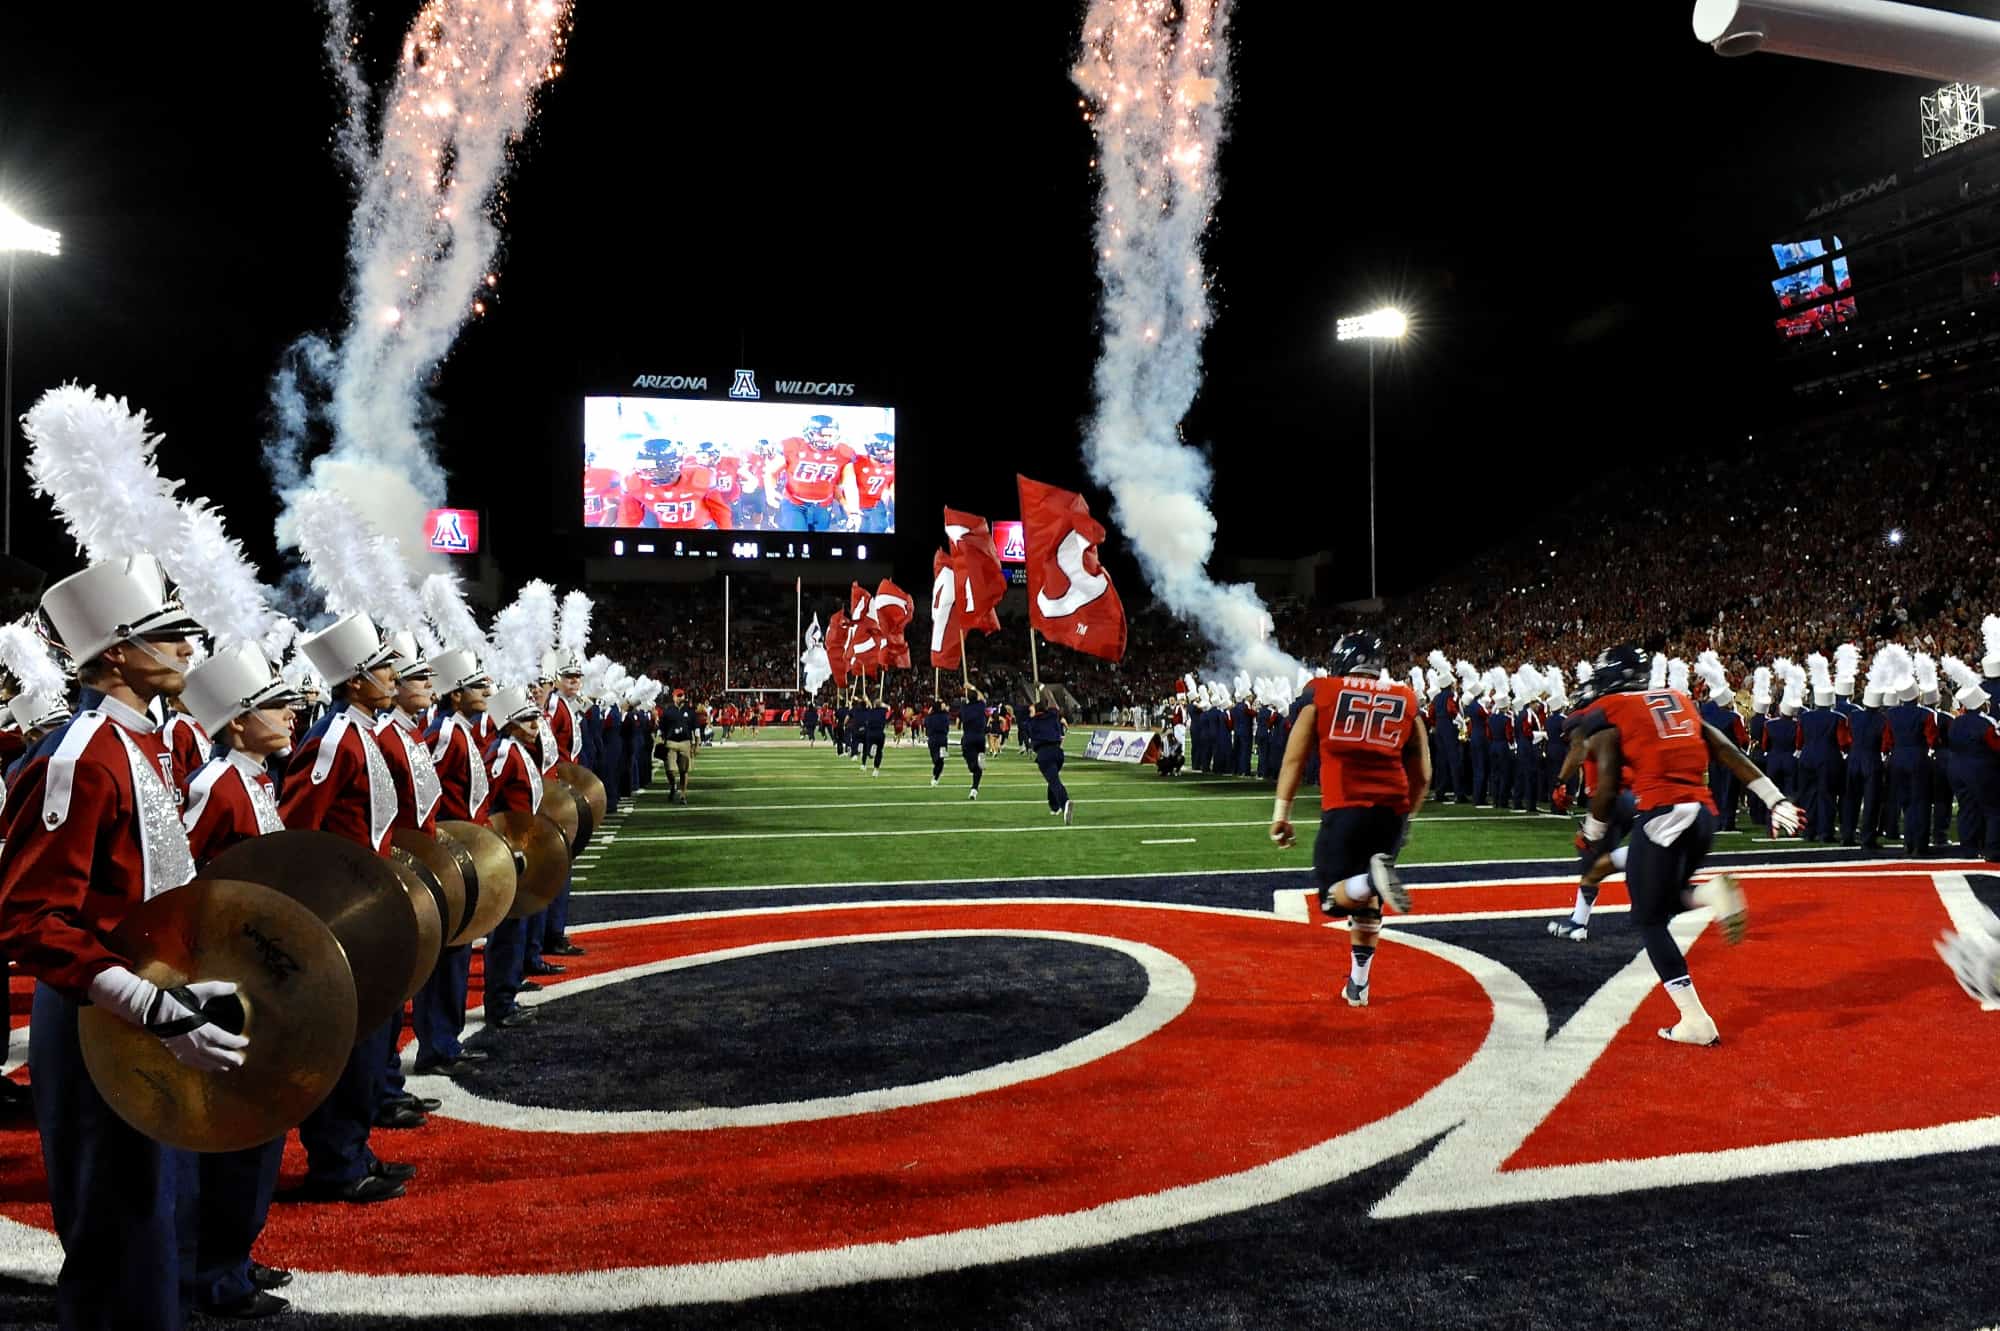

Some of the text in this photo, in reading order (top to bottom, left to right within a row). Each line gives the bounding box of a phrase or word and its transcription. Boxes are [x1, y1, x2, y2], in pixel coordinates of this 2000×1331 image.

[632, 374, 708, 391] ARIZONA
[775, 380, 855, 397] WILDCATS
[867, 476, 885, 495] 7
[654, 500, 695, 523] 21
[430, 511, 470, 551] A
[1075, 622, 1089, 636] TM
[1328, 689, 1407, 748] 62
[1642, 692, 1697, 739] 2
